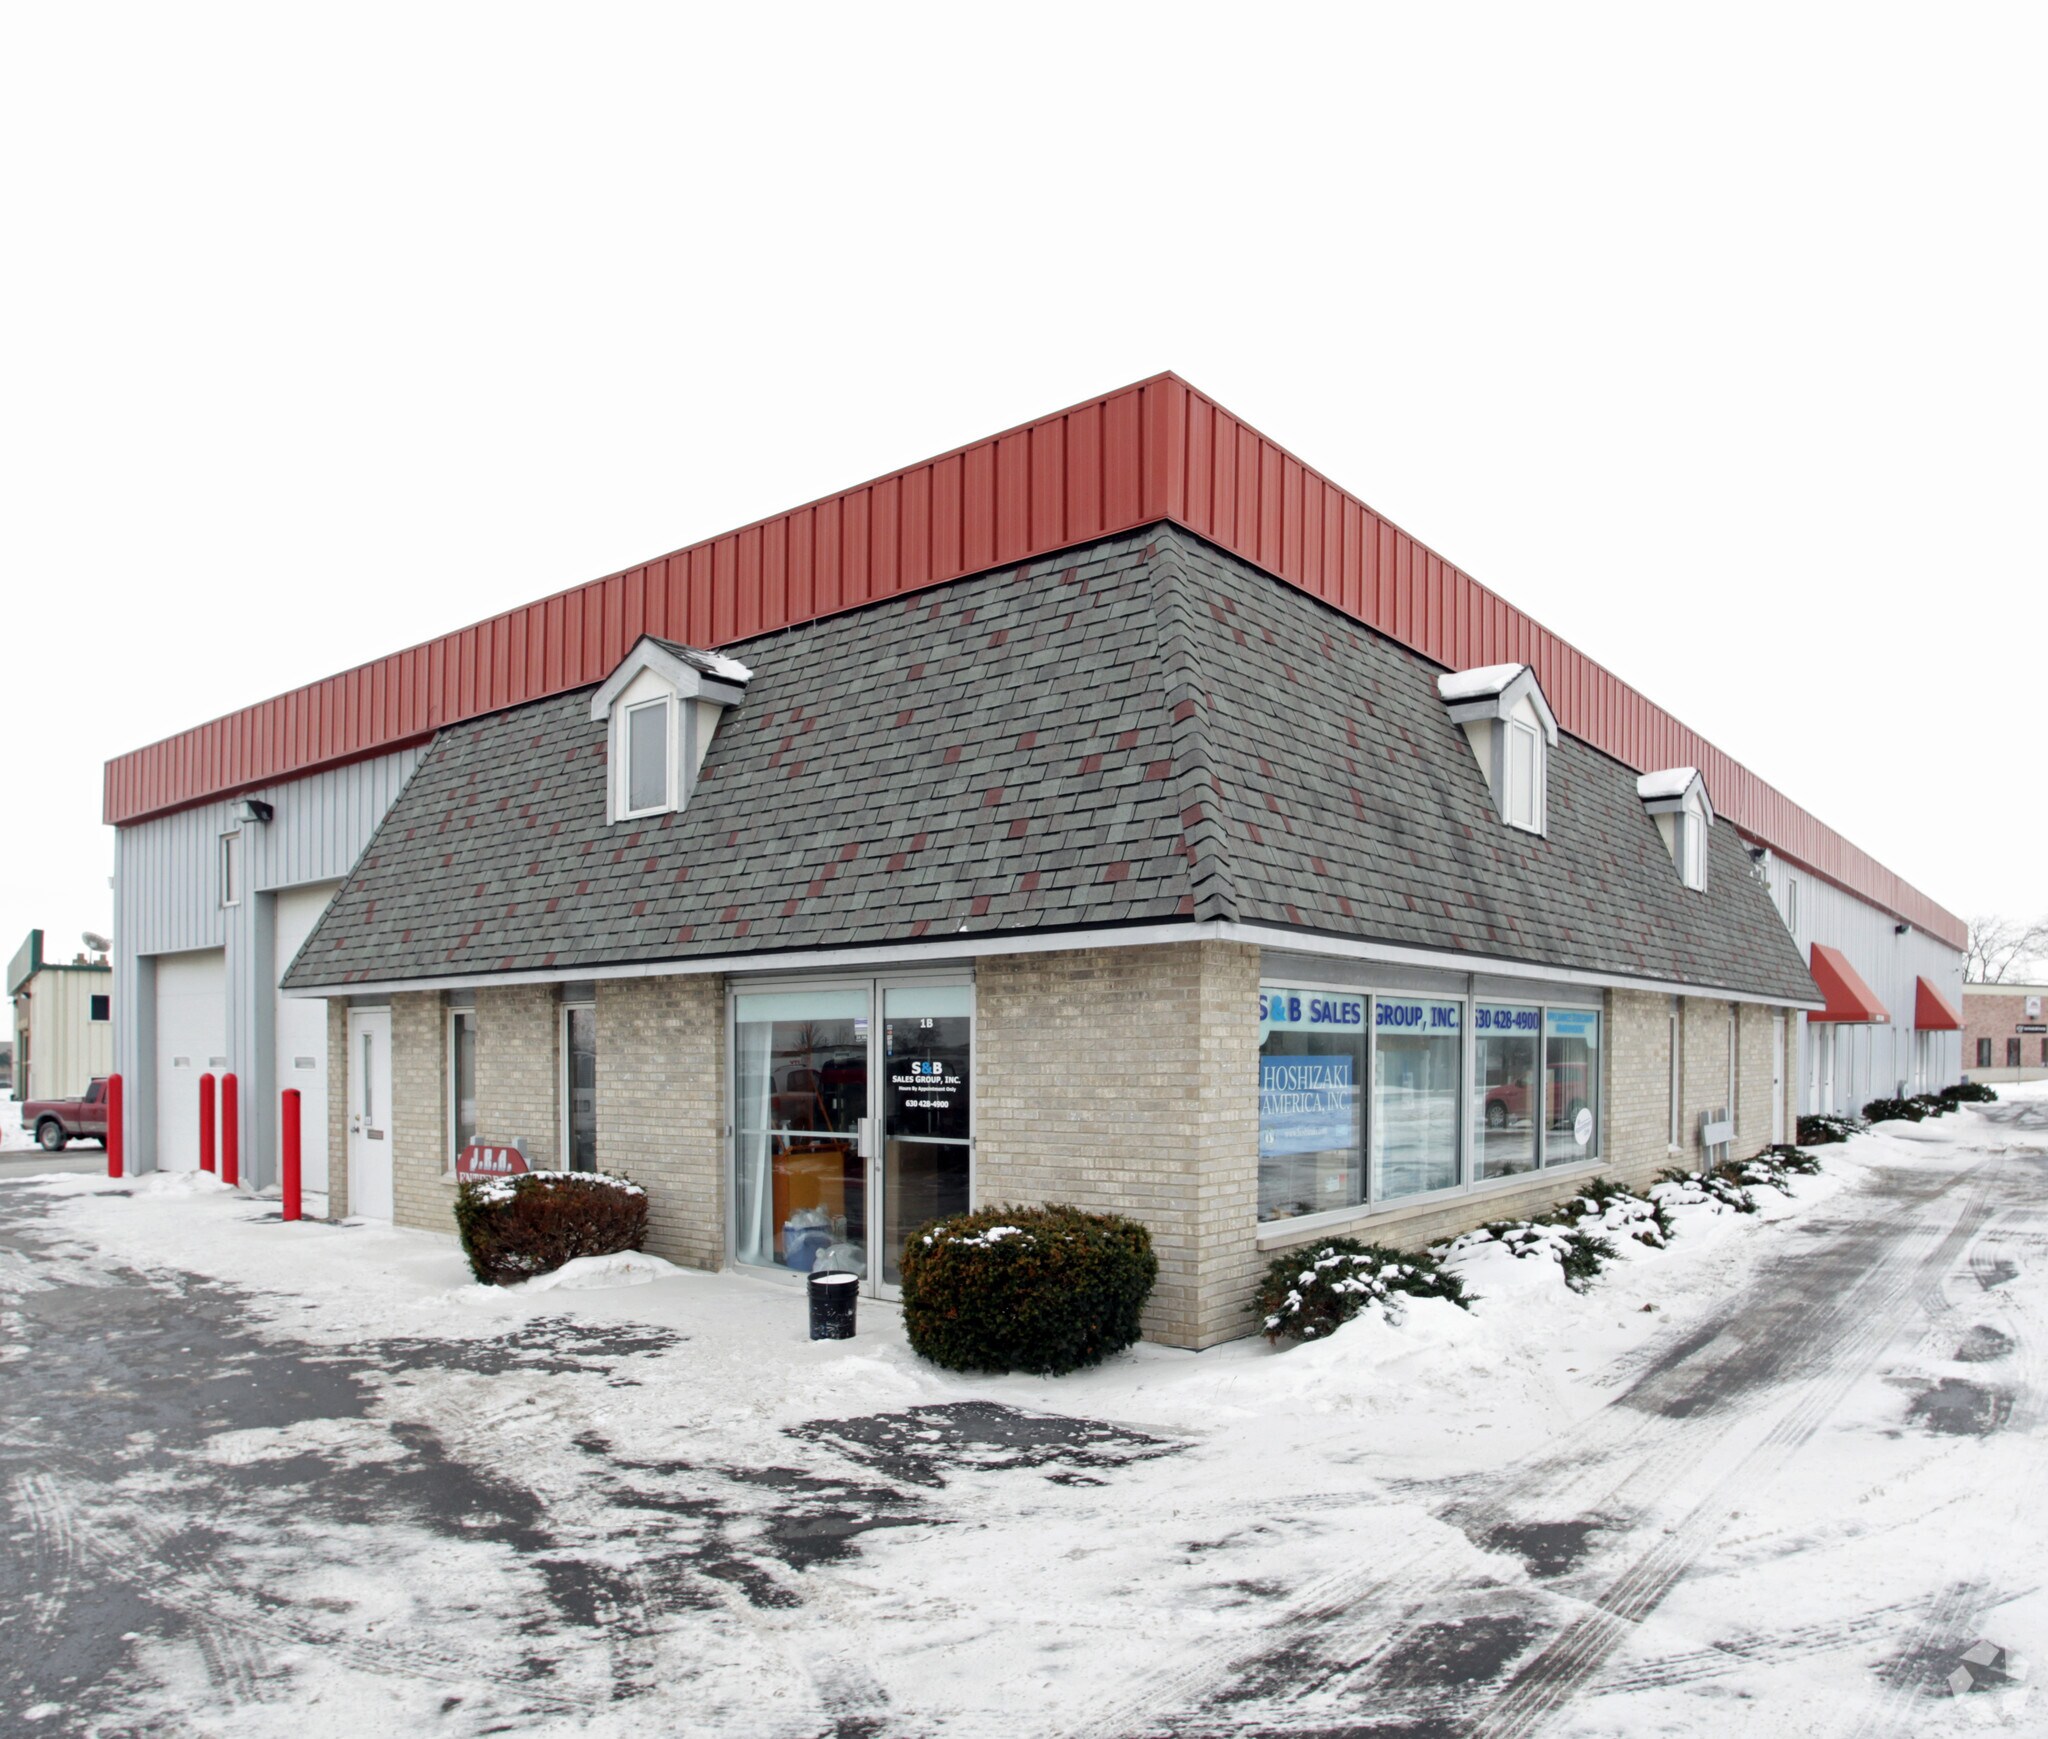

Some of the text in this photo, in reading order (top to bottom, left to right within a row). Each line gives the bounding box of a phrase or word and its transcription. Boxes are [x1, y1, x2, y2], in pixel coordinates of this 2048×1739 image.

[1310, 998, 1361, 1024] SALES
[1375, 1003, 1427, 1031] GROUP,
[1431, 1006, 1459, 1028] INC.
[1493, 1009, 1539, 1030] 428-4900
[920, 1018, 933, 1028] 1B
[911, 1061, 943, 1074] S&B
[892, 1075, 961, 1085] SALES GROUP, INC.
[1263, 1065, 1349, 1092] HOSHIZAKI
[918, 1100, 949, 1108] 428-4900
[1261, 1091, 1350, 1115] AMERICA, INC.
